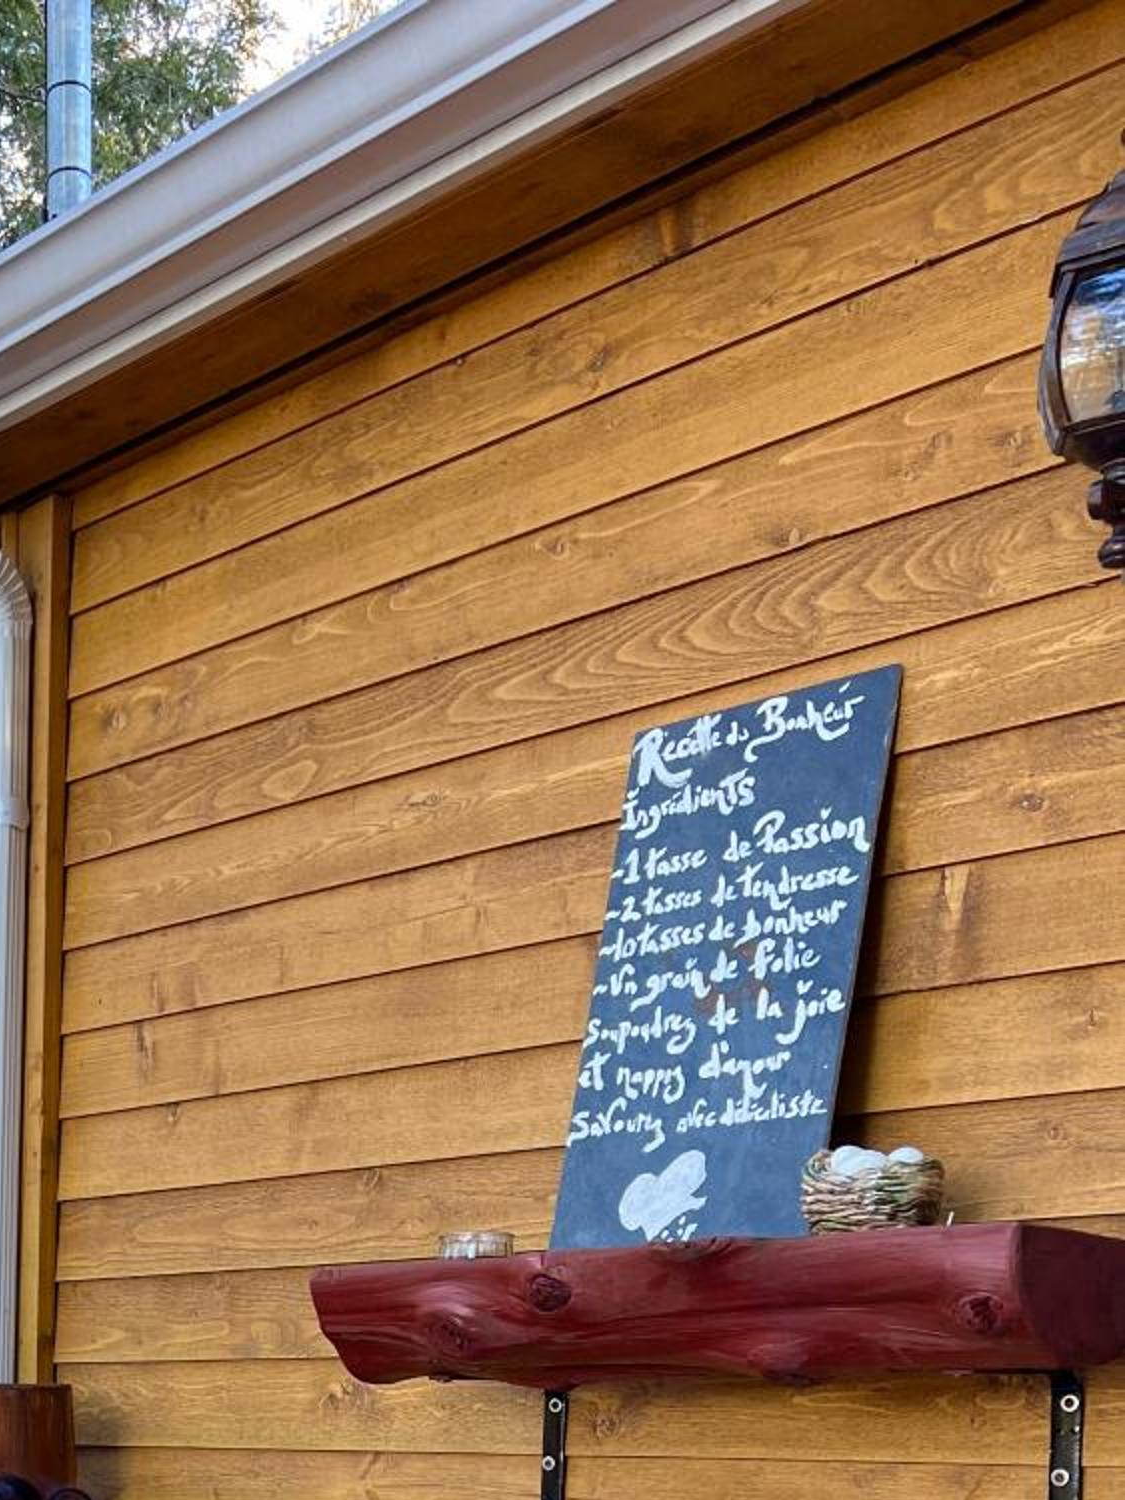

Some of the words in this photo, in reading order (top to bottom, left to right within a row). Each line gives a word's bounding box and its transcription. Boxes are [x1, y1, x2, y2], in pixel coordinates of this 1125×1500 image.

[633, 714, 722, 788] Recette
[726, 722, 749, 746] du
[723, 831, 751, 862] de
[711, 874, 738, 908] de
[708, 916, 735, 940] de
[734, 901, 848, 948] bonheur
[630, 957, 711, 1012] grain
[710, 950, 738, 983] de
[748, 937, 821, 980] folie
[708, 993, 739, 1034] de
[756, 987, 783, 1020] la
[775, 980, 846, 1044] joie
[578, 1051, 611, 1090] et
